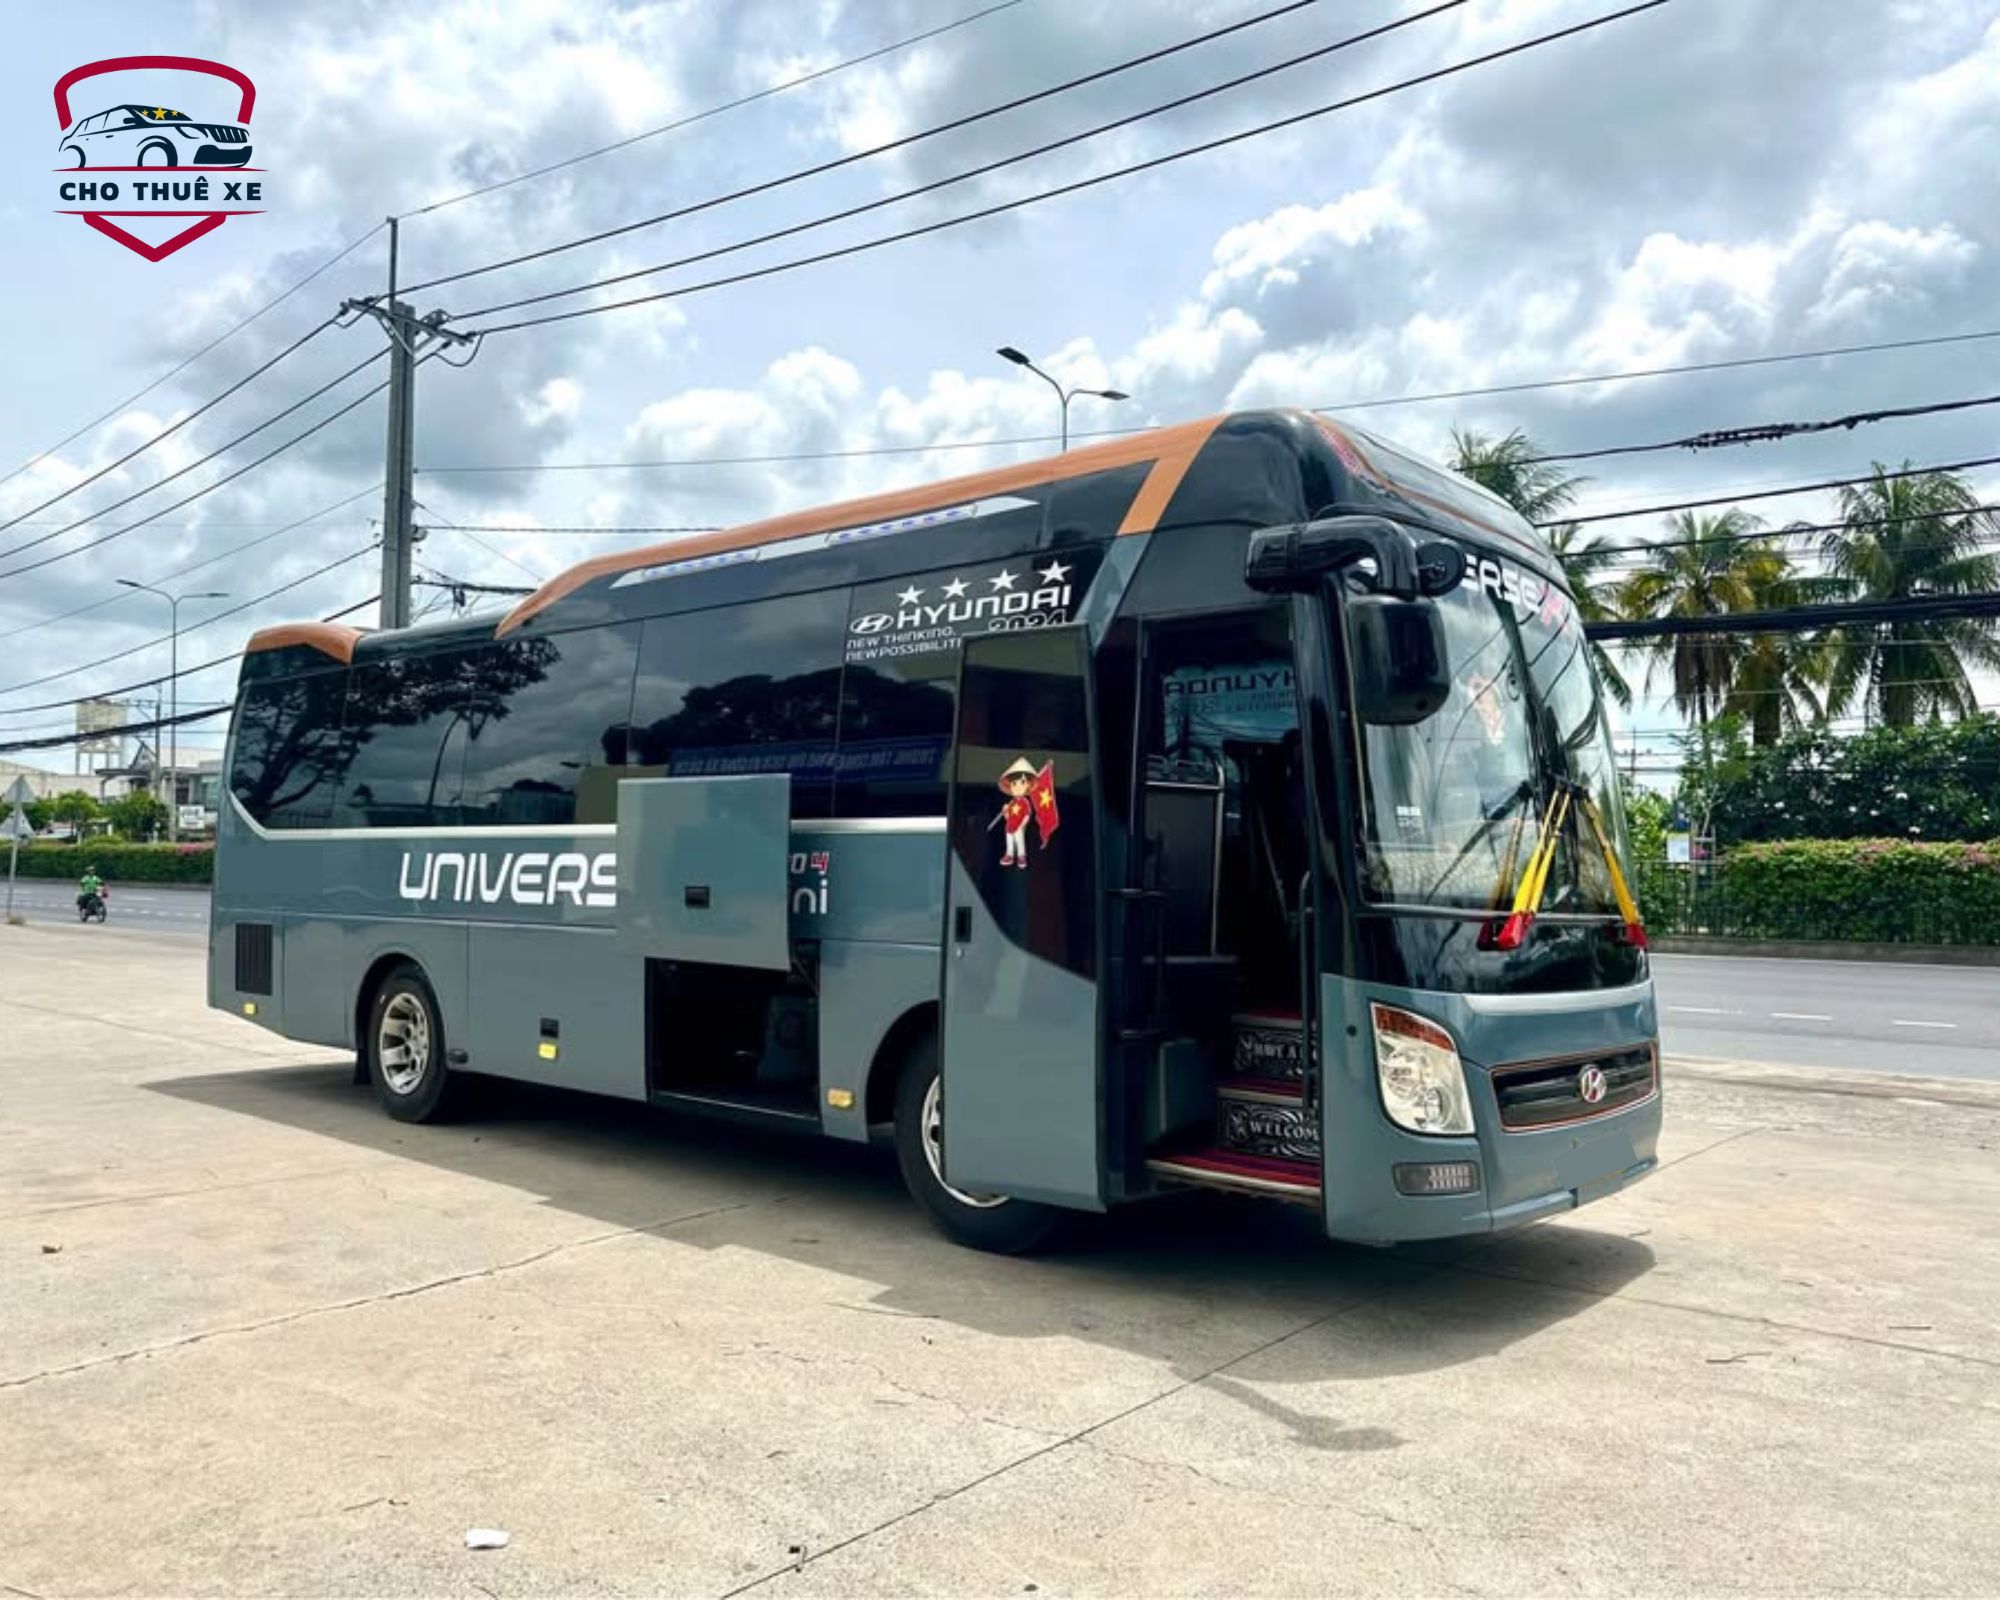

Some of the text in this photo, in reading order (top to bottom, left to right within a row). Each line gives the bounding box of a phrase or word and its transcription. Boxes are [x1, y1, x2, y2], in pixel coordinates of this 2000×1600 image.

[897, 584, 1072, 629] HYUNDAI
[847, 636, 881, 650] NEW
[846, 648, 879, 662] NEW
